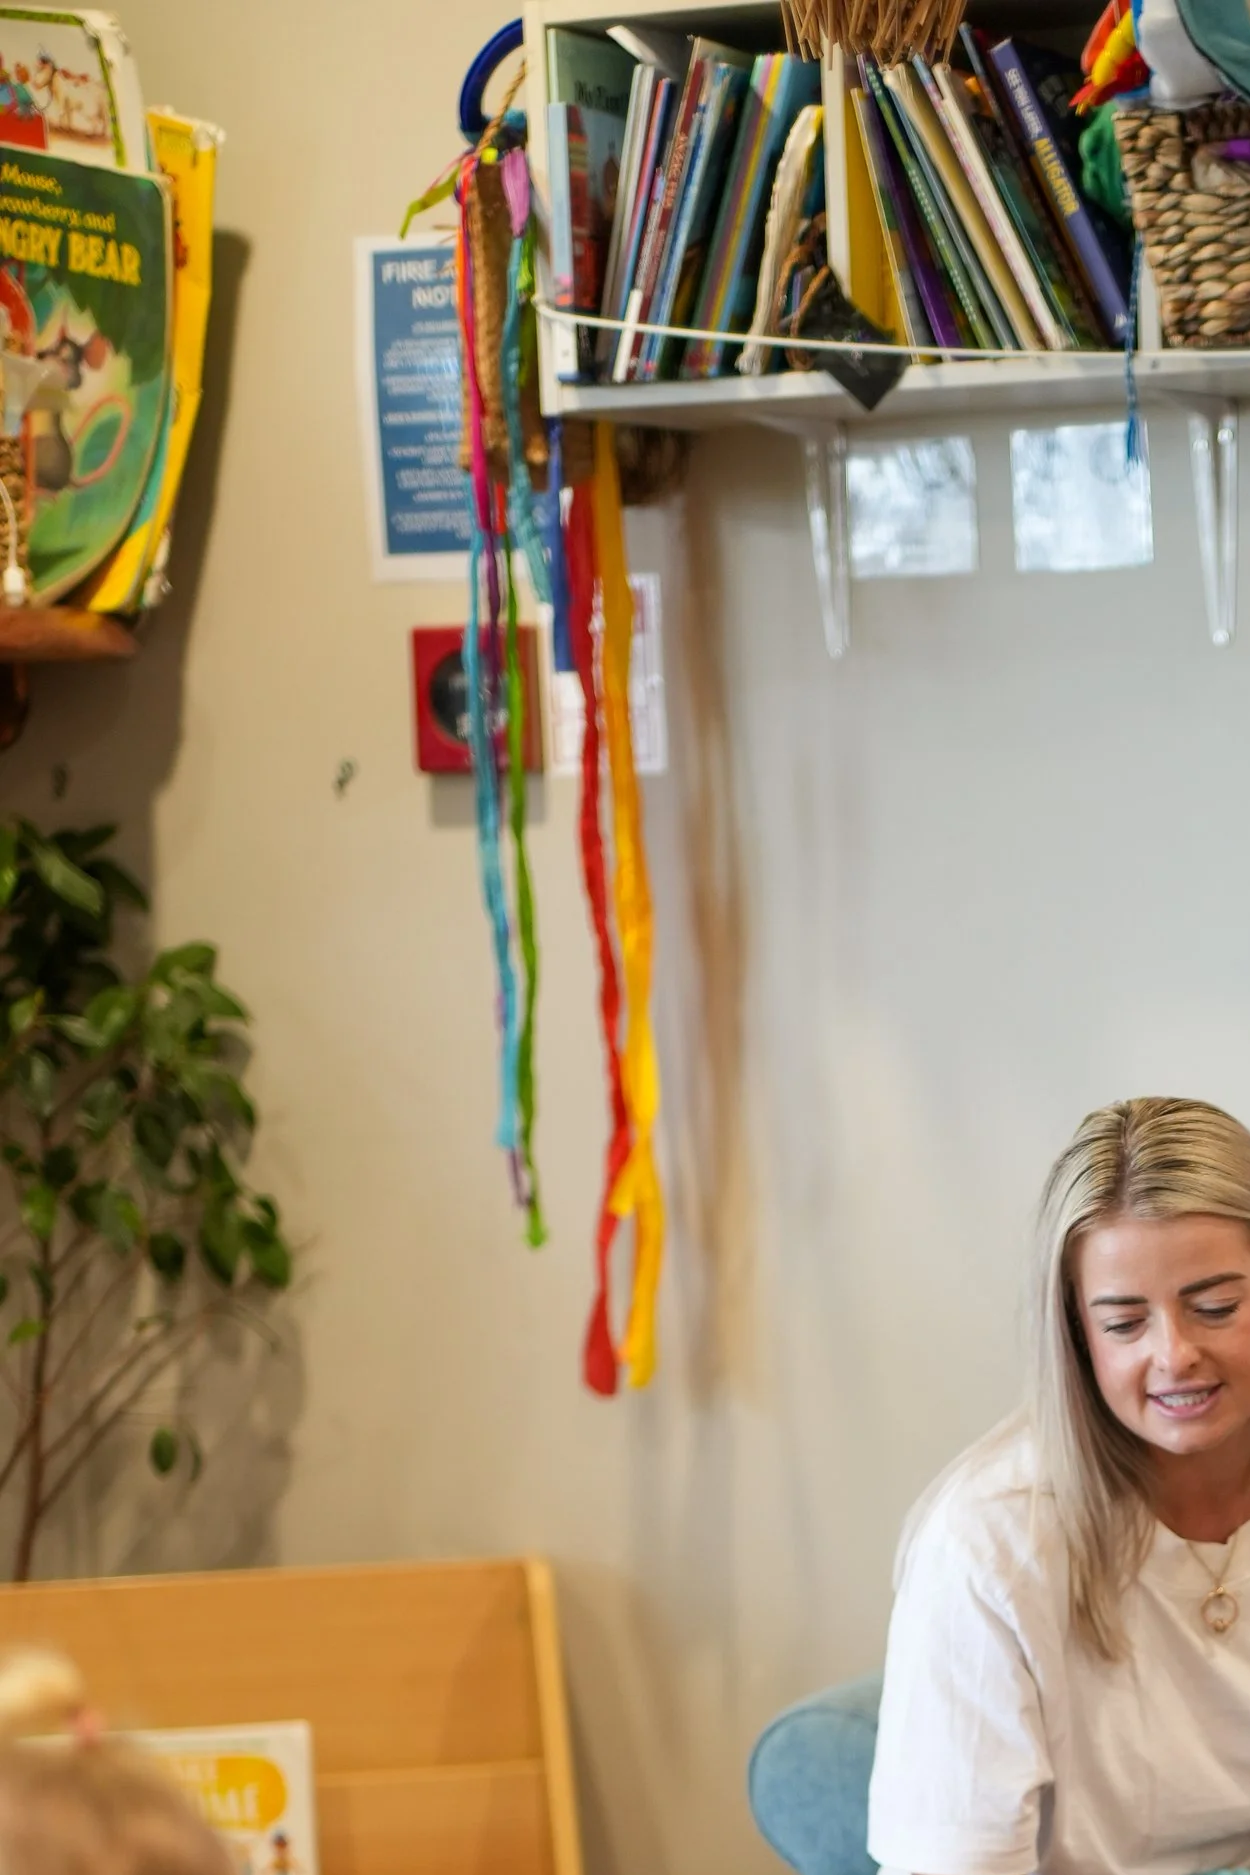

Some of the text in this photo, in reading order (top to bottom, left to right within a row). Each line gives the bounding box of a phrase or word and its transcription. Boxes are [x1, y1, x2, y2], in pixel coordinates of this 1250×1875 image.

[1033, 137, 1081, 217] ALLIGATOR
[67, 230, 142, 287] BEAR
[381, 258, 437, 284] FIRE
